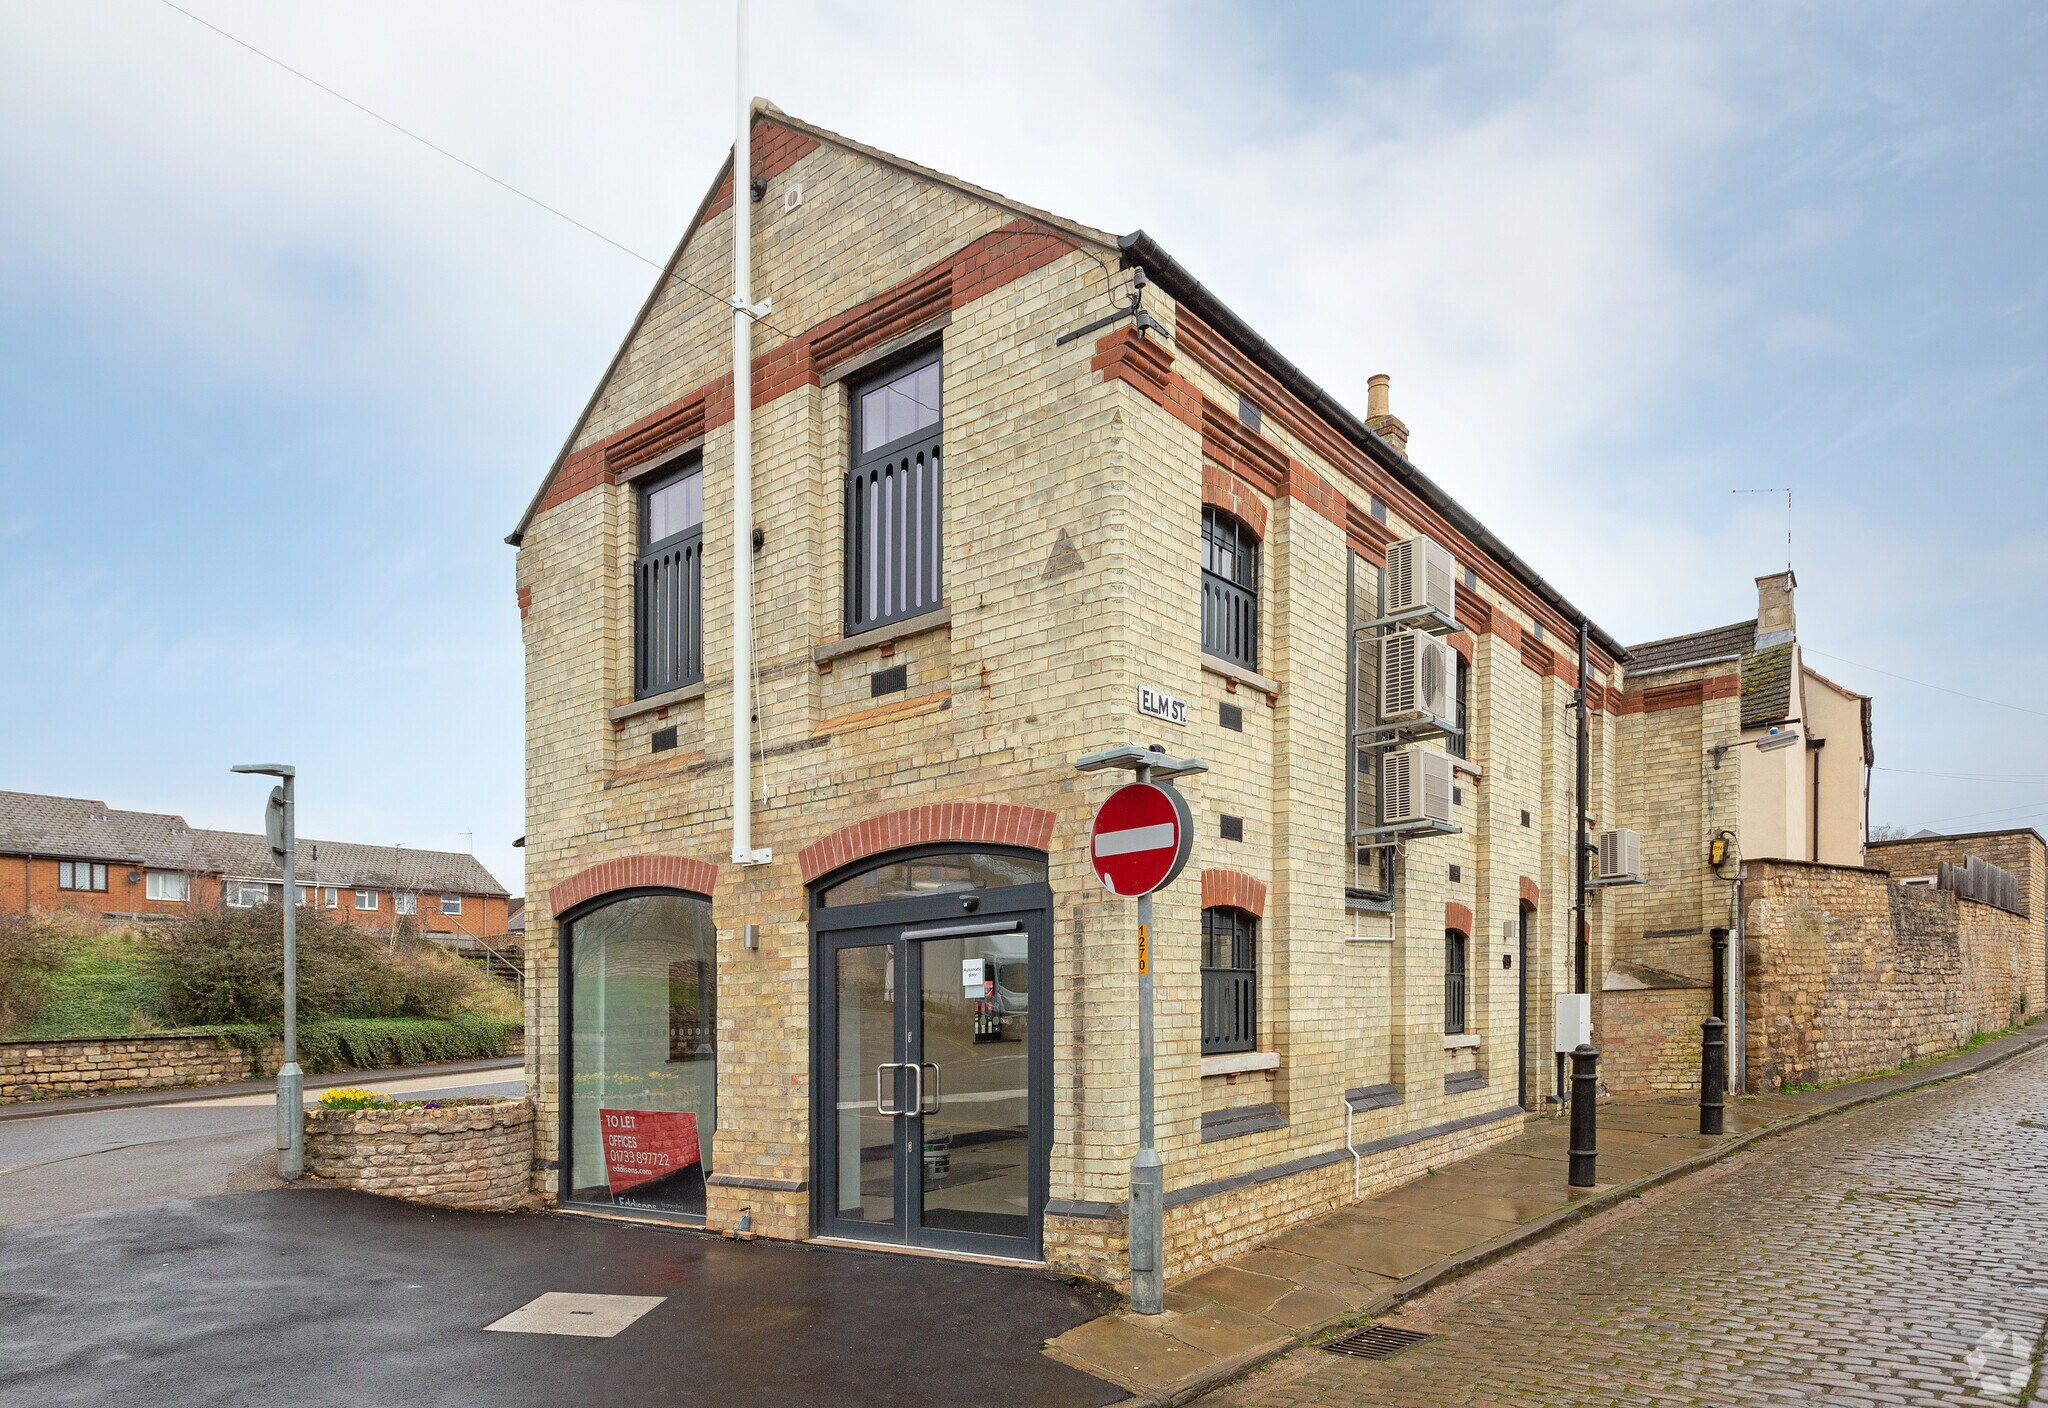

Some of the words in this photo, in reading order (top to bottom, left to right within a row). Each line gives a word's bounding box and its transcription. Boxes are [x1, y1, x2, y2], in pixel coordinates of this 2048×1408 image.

[1143, 690, 1168, 717] ELM
[1172, 700, 1186, 722] ST.
[606, 1115, 619, 1128] TO
[620, 1115, 635, 1129] LET
[609, 1134, 637, 1148] OFFICES
[610, 1149, 635, 1164] 01733
[636, 1151, 670, 1167] 897722
[613, 1164, 652, 1175] eddisons.com
